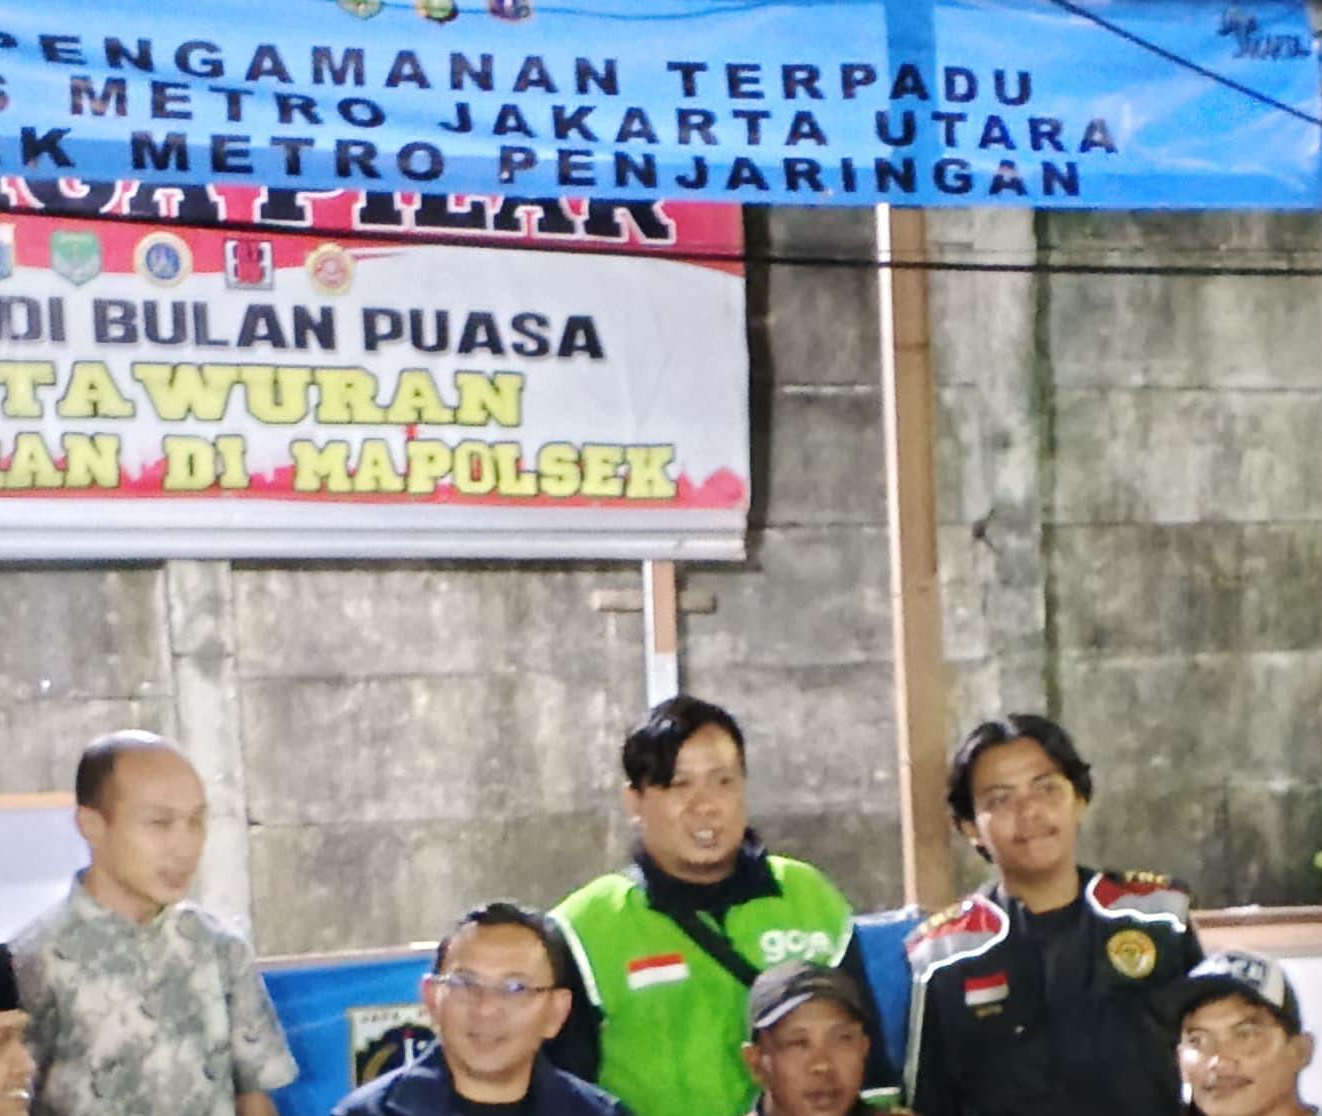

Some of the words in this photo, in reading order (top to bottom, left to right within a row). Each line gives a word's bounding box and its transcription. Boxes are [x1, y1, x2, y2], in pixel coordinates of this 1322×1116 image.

[70, 77, 385, 128] METRO
[440, 102, 827, 146] JAKARTA
[877, 110, 1119, 155] UTARA
[668, 62, 1033, 106] TERPADU
[131, 132, 445, 180] METRO
[499, 146, 1083, 197] PENJARINGAN
[94, 299, 337, 350] BULAN
[363, 308, 604, 360] PUASA
[163, 434, 251, 492] DI
[290, 438, 677, 500] MAPOLSEK
